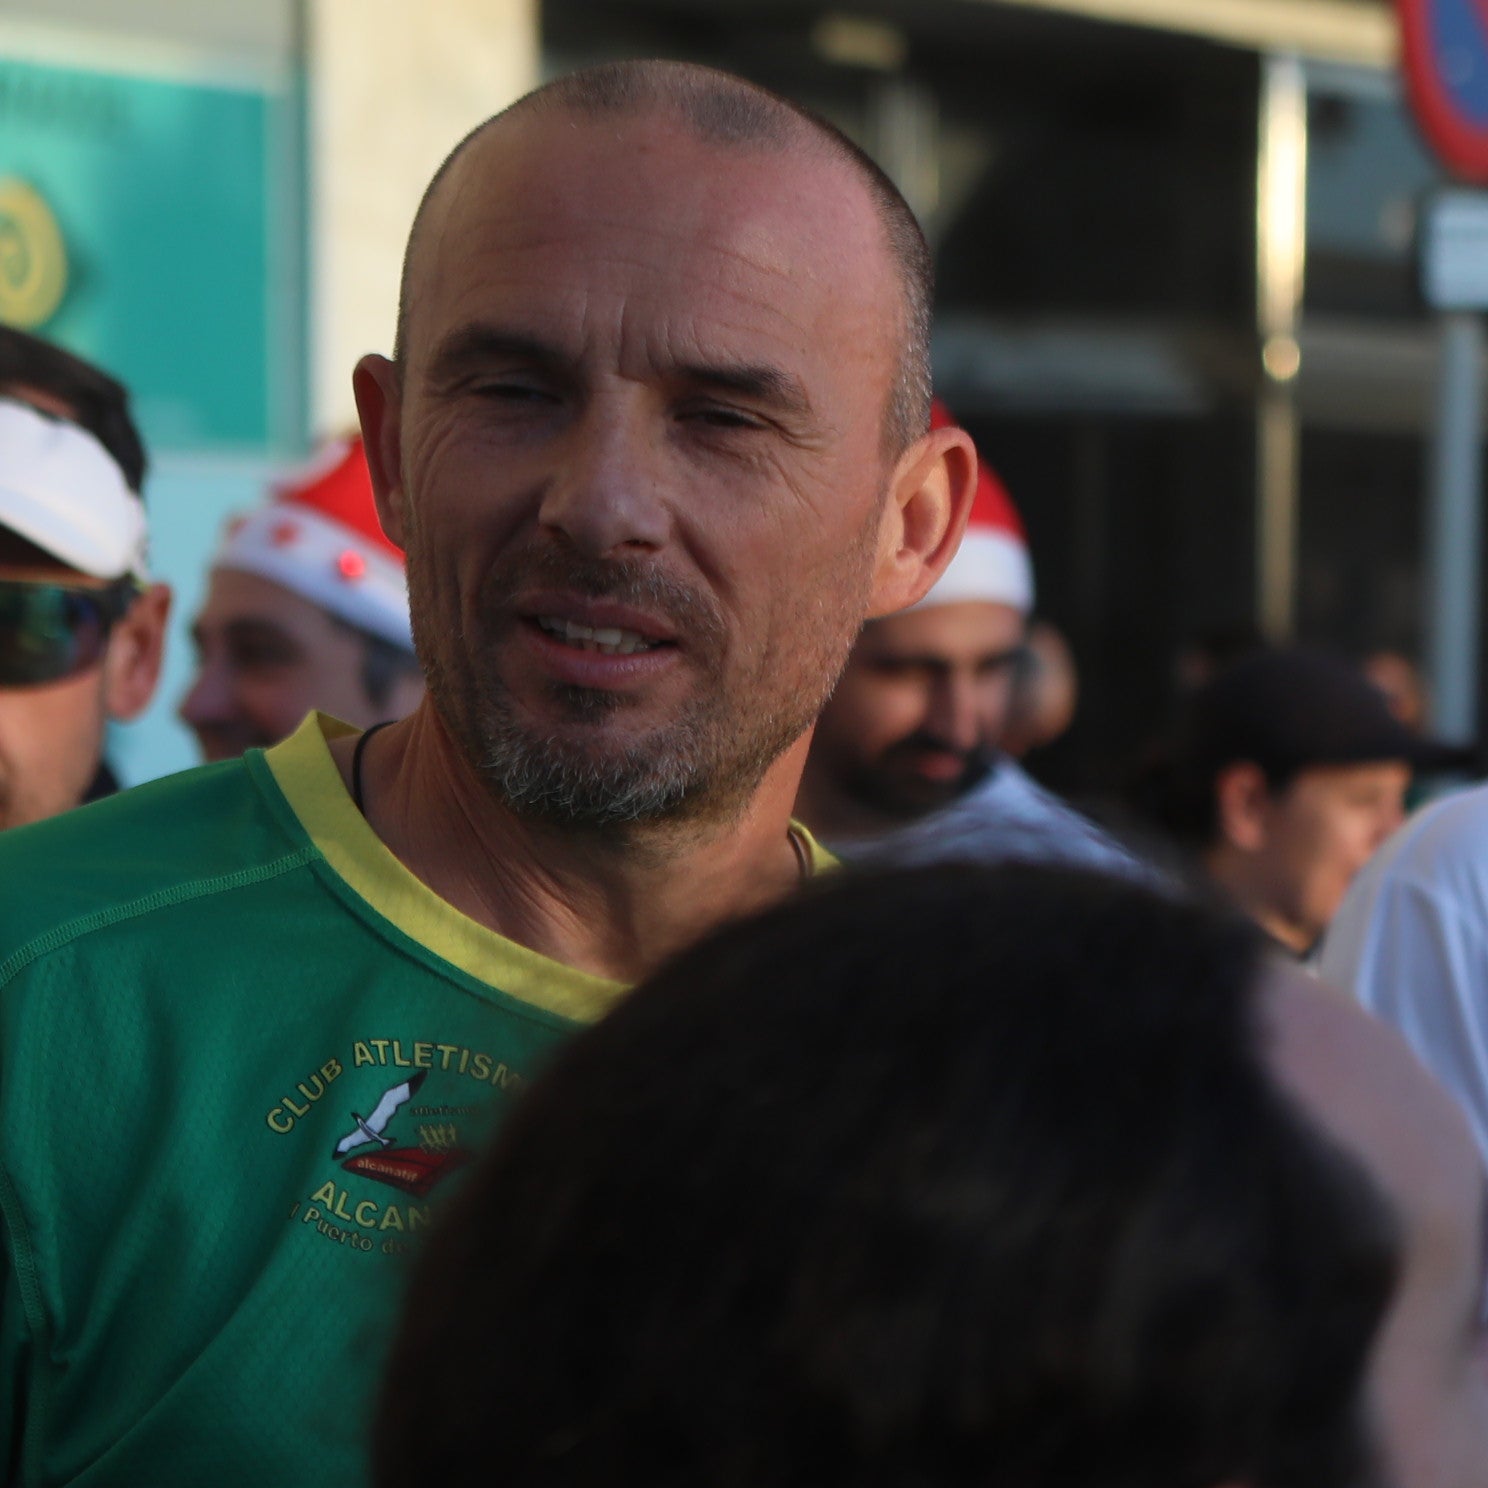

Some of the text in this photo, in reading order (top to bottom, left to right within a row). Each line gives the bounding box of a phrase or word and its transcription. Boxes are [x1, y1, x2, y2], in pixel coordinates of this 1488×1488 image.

[266, 1039, 528, 1134] CLUB ATLETISM
[303, 1207, 374, 1252] Puerto
[310, 1179, 434, 1233] ALCAN
